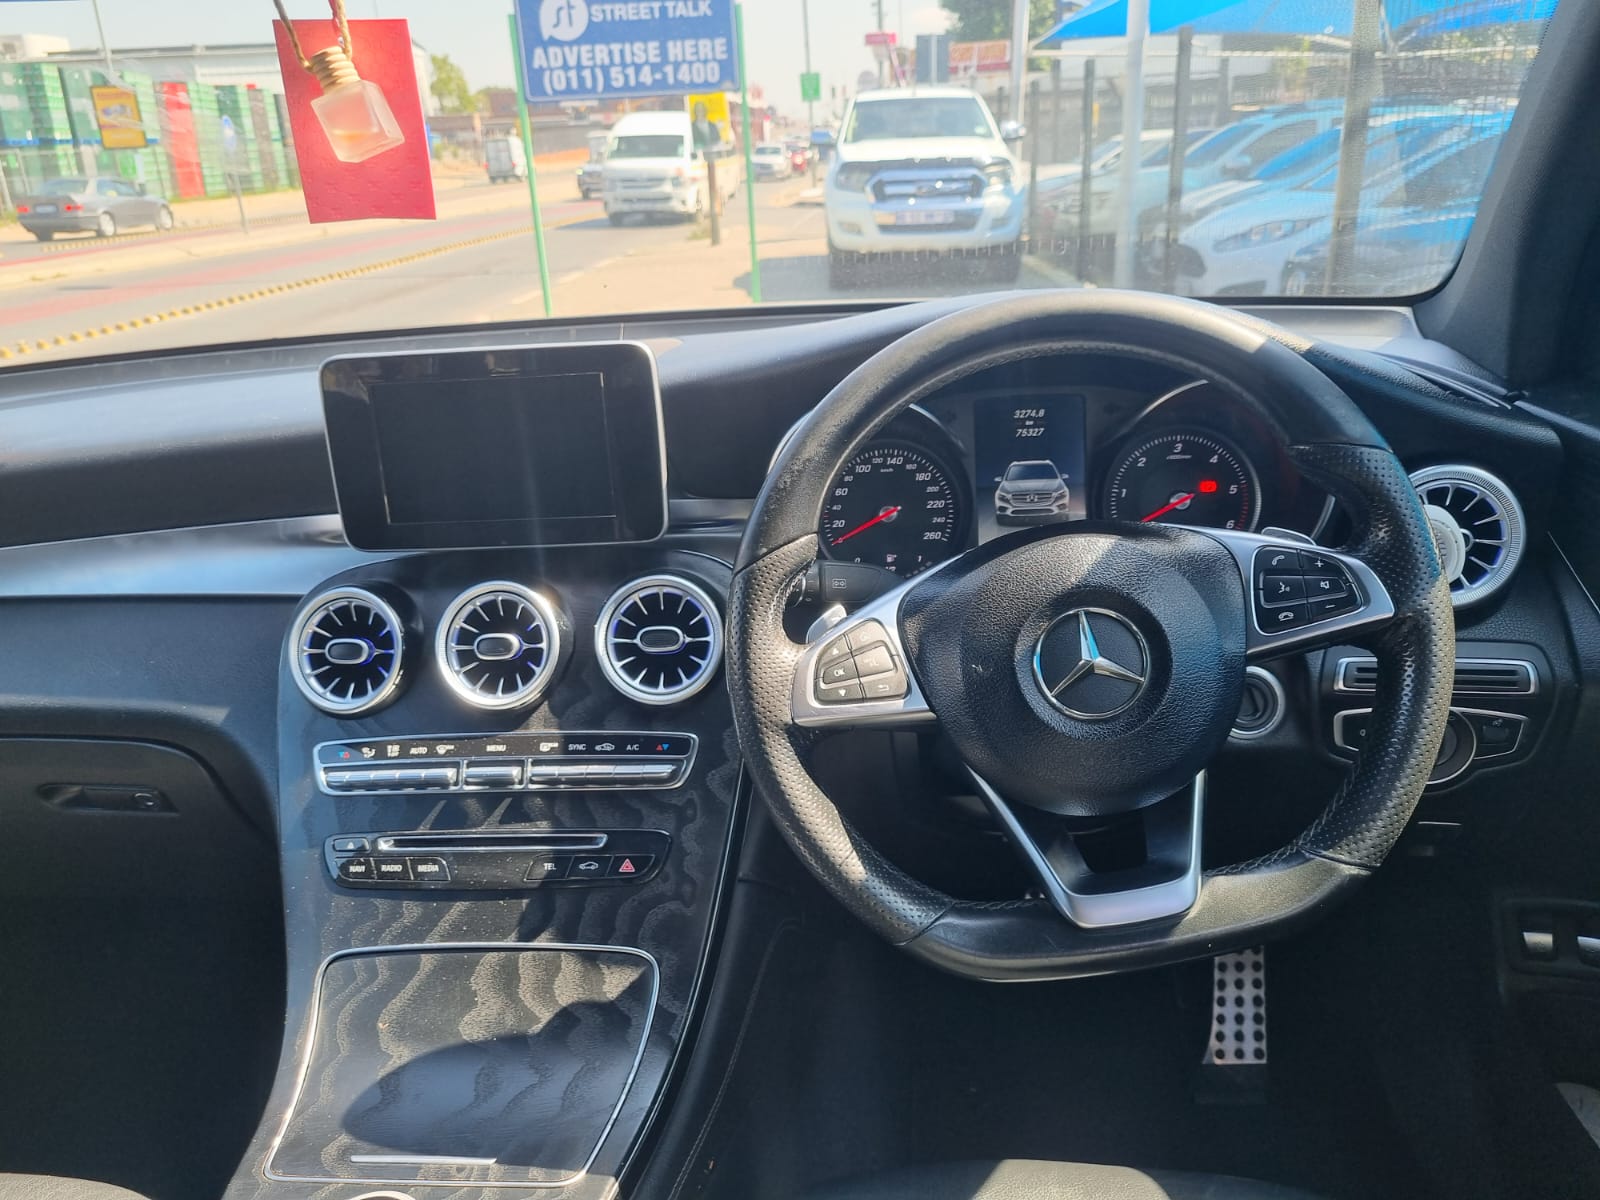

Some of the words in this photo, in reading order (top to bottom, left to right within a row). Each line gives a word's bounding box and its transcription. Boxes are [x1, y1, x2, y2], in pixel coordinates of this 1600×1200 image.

[590, 2, 660, 22] STREET
[664, 1, 713, 18] TALK
[532, 40, 662, 69] ADVERTISE
[667, 37, 728, 62] HERE
[543, 67, 604, 95] (011)
[609, 61, 721, 87] 514-1400
[1015, 427, 1045, 438] 75327
[1173, 443, 1183, 453] 3
[886, 457, 903, 465] 140
[1137, 457, 1147, 467] 2
[1209, 454, 1219, 464] 4
[855, 465, 871, 473] 100
[915, 473, 931, 481] 180
[835, 488, 848, 496] 60
[1121, 488, 1127, 498] 1
[1229, 485, 1238, 494] 5
[926, 500, 945, 509] 220
[833, 519, 846, 528] 20
[1226, 520, 1235, 529] 6
[923, 532, 942, 540] 260
[833, 667, 846, 677] OK
[568, 743, 587, 751] SYNC
[626, 743, 640, 751] A/C
[381, 864, 403, 873] RADIO
[417, 864, 440, 873] MEDIA
[543, 862, 556, 871] TEL
